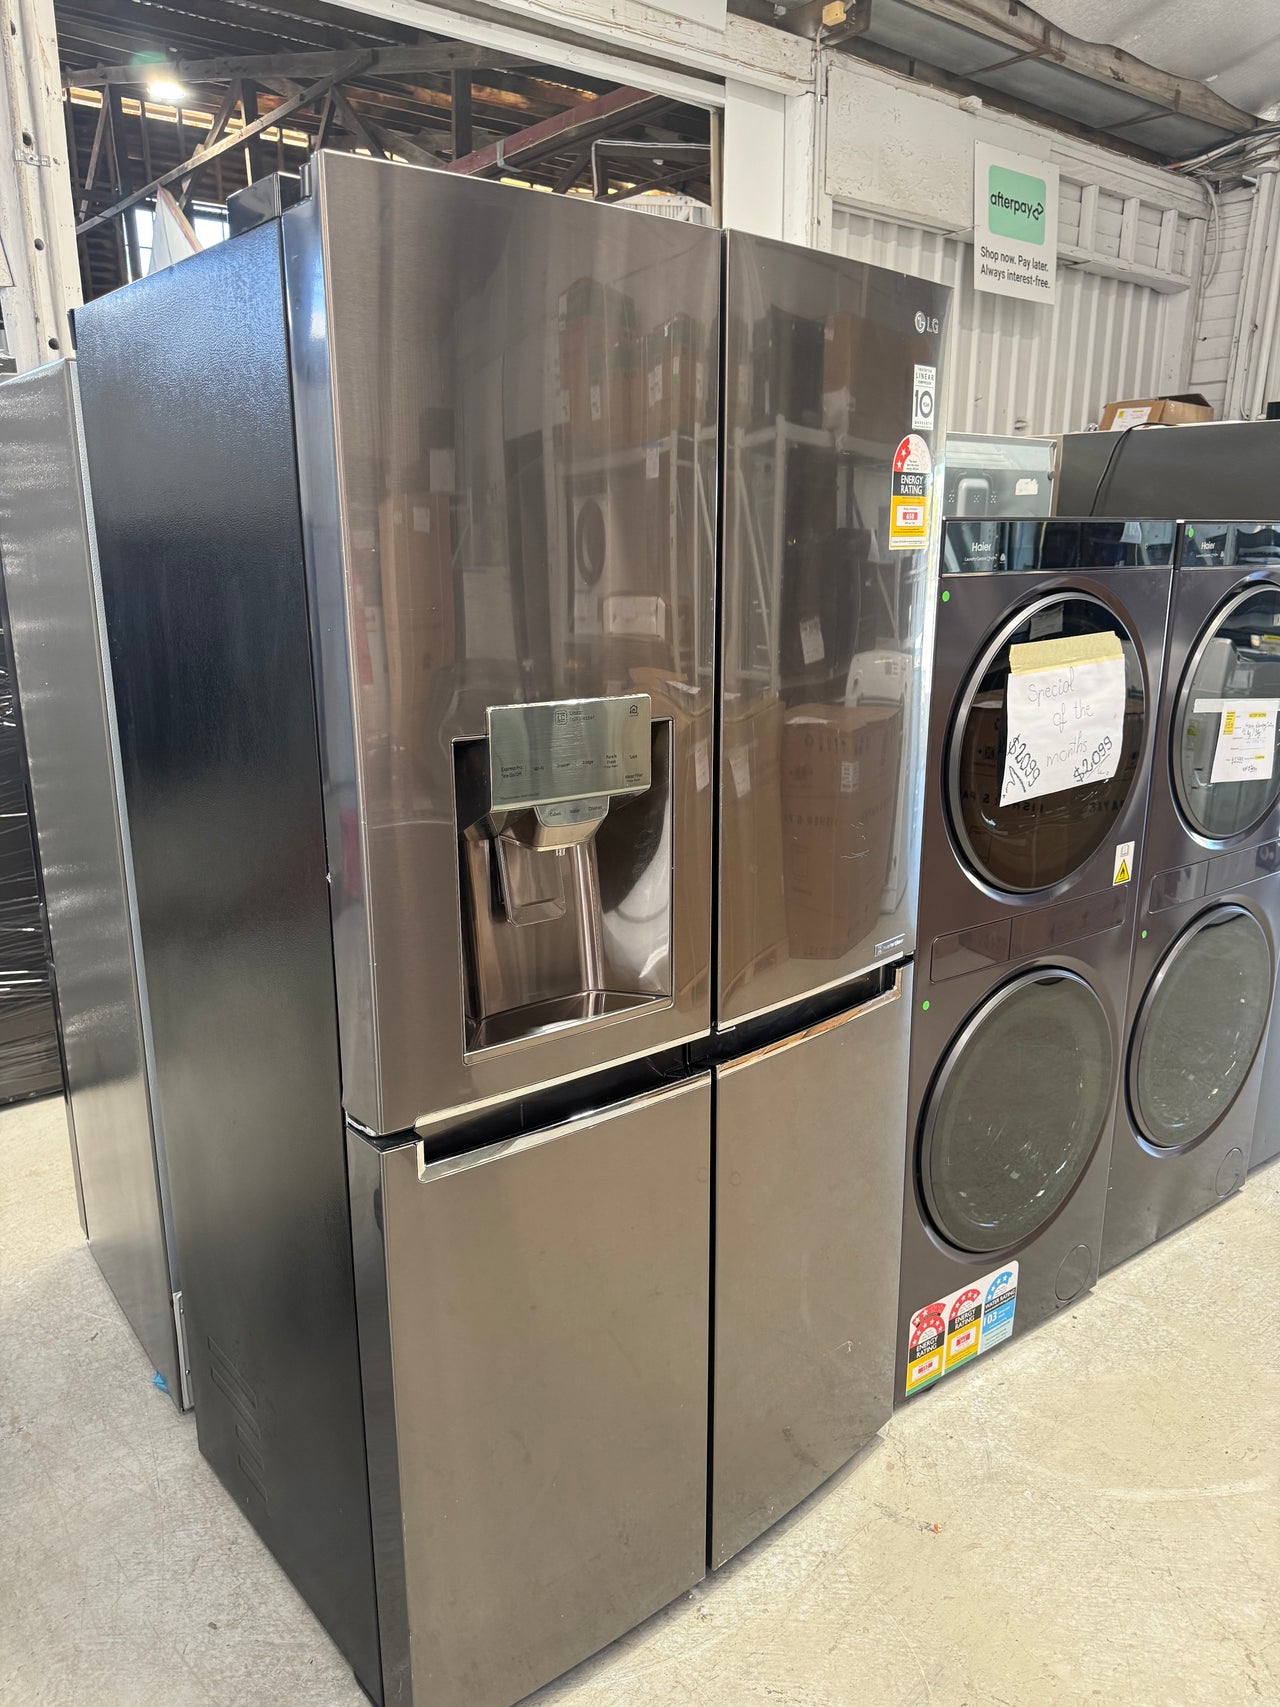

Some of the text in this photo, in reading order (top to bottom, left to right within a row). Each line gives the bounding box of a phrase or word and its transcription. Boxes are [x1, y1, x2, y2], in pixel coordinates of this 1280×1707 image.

[990, 192, 1033, 218] afterpay
[980, 246, 1049, 272] Shop now. Pay later.
[980, 263, 1051, 289] Always interest-free.
[915, 372, 935, 381] LINEAR
[915, 389, 933, 419] 10
[900, 475, 923, 485] ENERGY
[900, 485, 923, 495] RATING
[971, 541, 992, 552] Haier
[1200, 541, 1216, 550] Haier
[1027, 666, 1075, 707] Special
[1052, 699, 1094, 734] of the
[1046, 730, 1088, 768] months
[1008, 732, 1041, 788] $2099
[1073, 735, 1113, 783] $2099
[954, 1308, 976, 1324] ENERGY
[954, 1316, 975, 1330] RATING
[983, 1312, 997, 1327] 103
[916, 1336, 938, 1352] ENERGY
[916, 1343, 937, 1358] RATING
